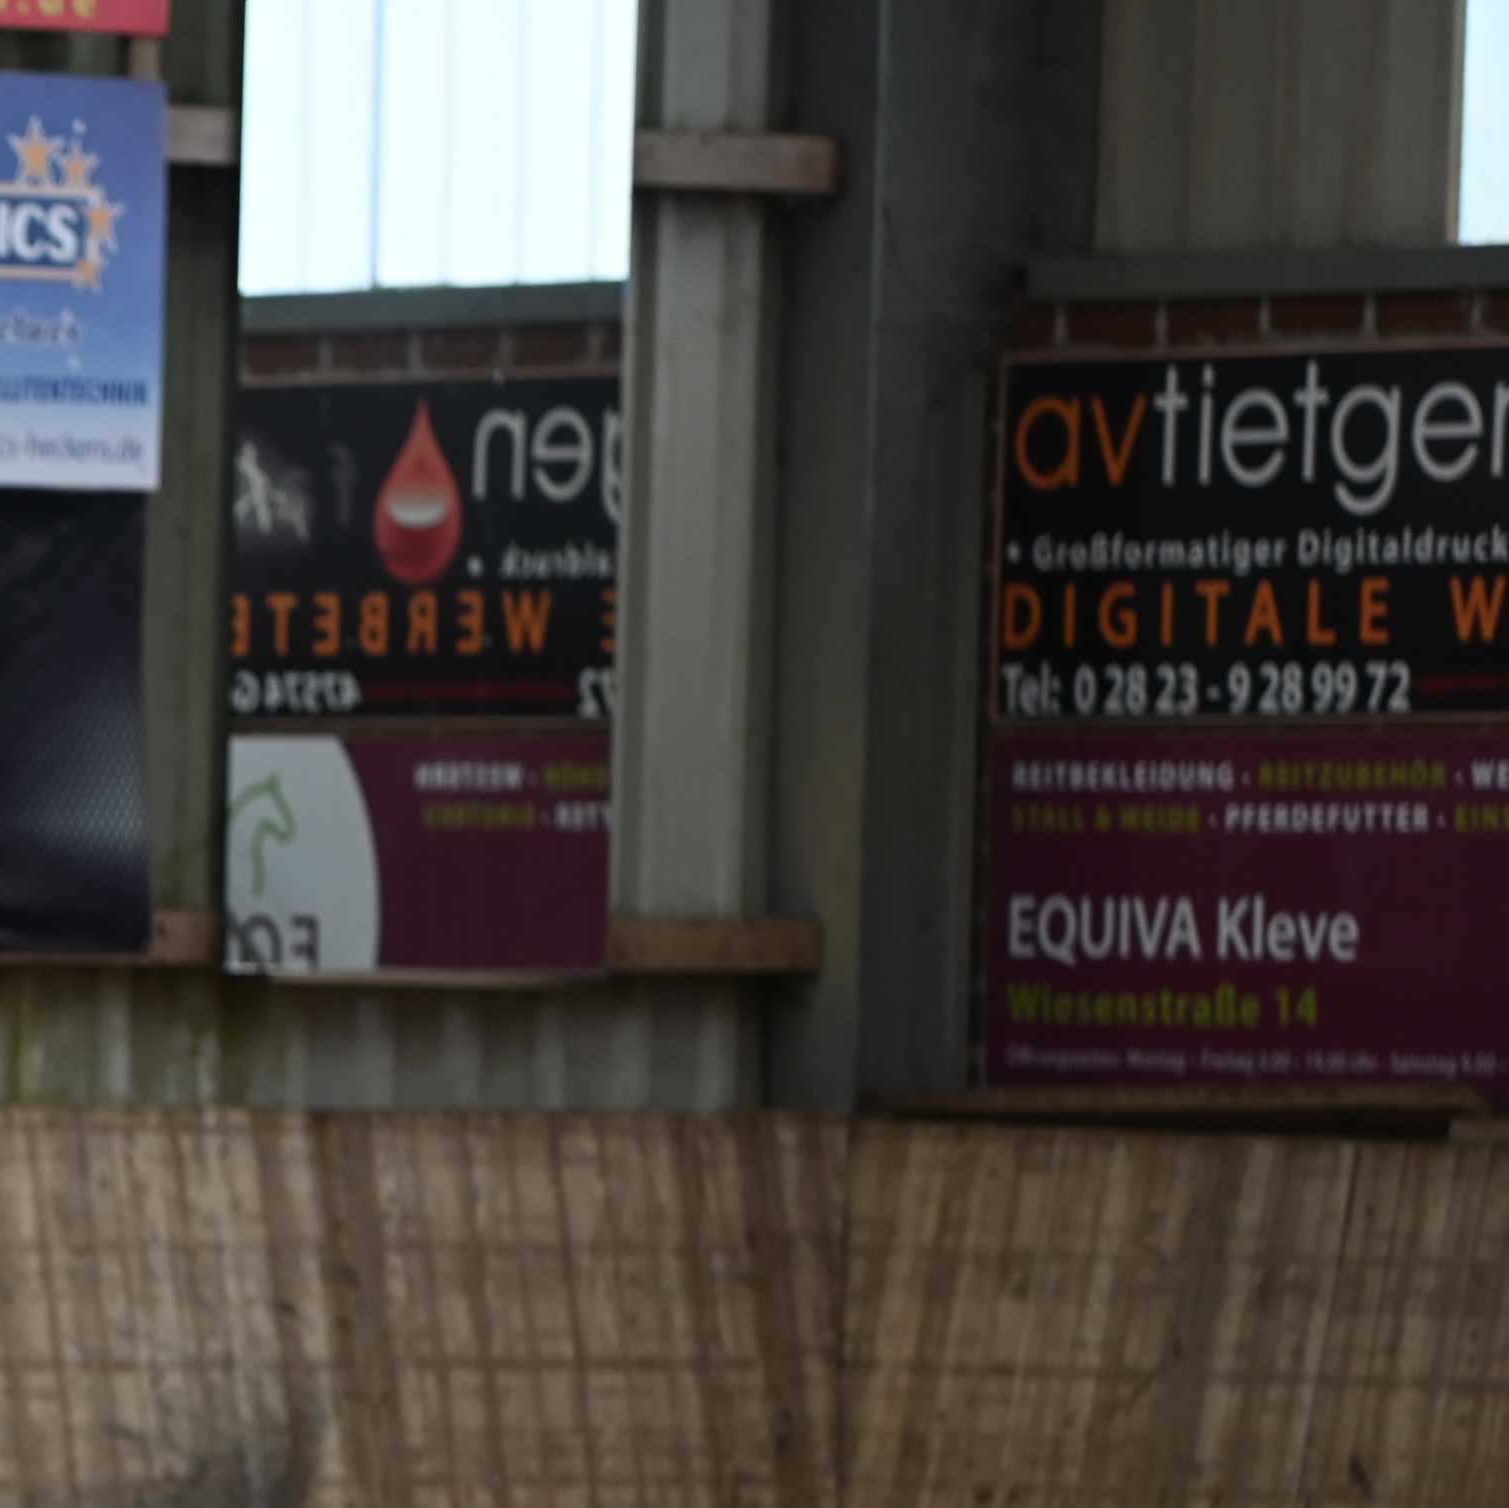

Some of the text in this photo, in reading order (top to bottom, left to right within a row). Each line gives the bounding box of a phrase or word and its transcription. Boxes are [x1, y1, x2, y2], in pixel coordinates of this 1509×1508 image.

[1033, 529, 1287, 576] Großformatiger
[1002, 575, 1391, 650] DIGITALE
[1010, 760, 1236, 792] REITBEKLEIDUNG
[1224, 802, 1430, 835] PFERDEFUTTER
[1007, 893, 1361, 966] EQUIVA Kleve
[1008, 981, 1319, 1028] Wiesenstraße 14
